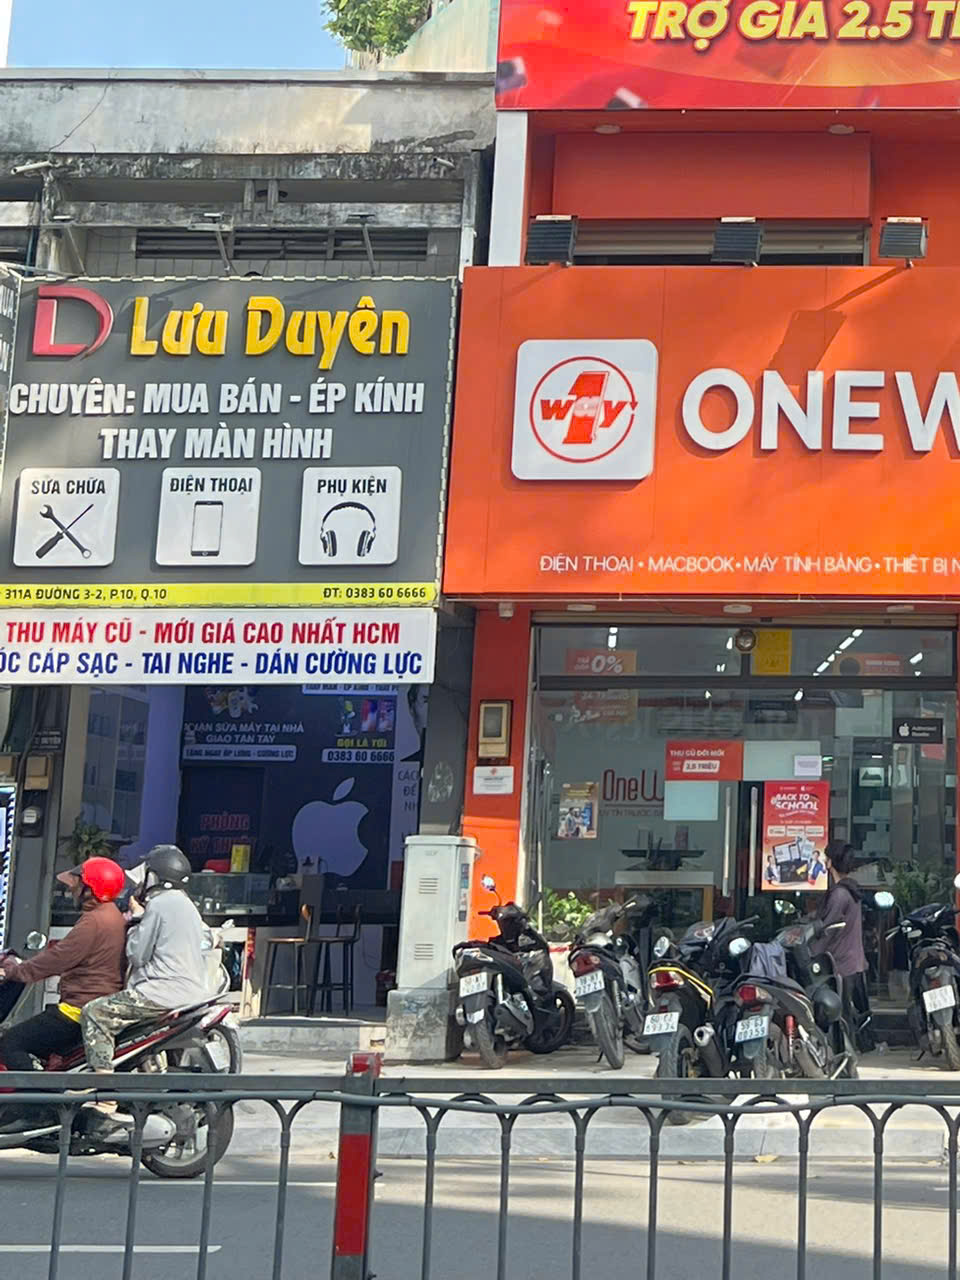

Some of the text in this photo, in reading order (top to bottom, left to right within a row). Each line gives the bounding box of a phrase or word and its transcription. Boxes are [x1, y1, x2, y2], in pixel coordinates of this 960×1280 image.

[834, 0, 912, 39] 2.5
[130, 295, 410, 370] Lưu Duyên
[9, 377, 424, 416] CHUYÊN: MUA BÁN ÉP KÍNH
[101, 422, 333, 460] THAY MÀN HÌNH
[66, 477, 105, 494] CHỮA
[170, 475, 253, 496] ĐIỆN THOẠI
[317, 476, 387, 496] PHỤ KIỆN
[540, 553, 578, 573] ĐIỆN
[648, 556, 736, 572] MACBOOK
[744, 554, 778, 572] MÁY
[783, 553, 820, 573] TÍNH
[824, 553, 872, 573] BẢNG
[933, 556, 948, 576] BỊ
[5, 588, 32, 600] 311A
[35, 587, 80, 600] ĐƯỜNG
[84, 588, 106, 601] 3-2,
[140, 588, 167, 600] Q.10
[323, 587, 426, 598] ĐT: 0383 60 6666
[6, 617, 400, 644] THU MÁY CŨ MỚI GIÁ CAO NHẤT HCM
[28, 648, 70, 673] CÁP
[77, 652, 118, 677] SẠC
[142, 652, 171, 674] TAI
[178, 652, 234, 674] NGHE
[255, 648, 299, 674] DÁN
[305, 648, 377, 675] CƯỜNG
[383, 650, 422, 679] LỰC
[592, 655, 624, 673] 0%
[206, 734, 232, 744] GIAO
[328, 751, 352, 761] 0383
[355, 751, 368, 761] 60
[775, 793, 809, 801] BACK TO
[775, 801, 818, 811] SCHOOL
